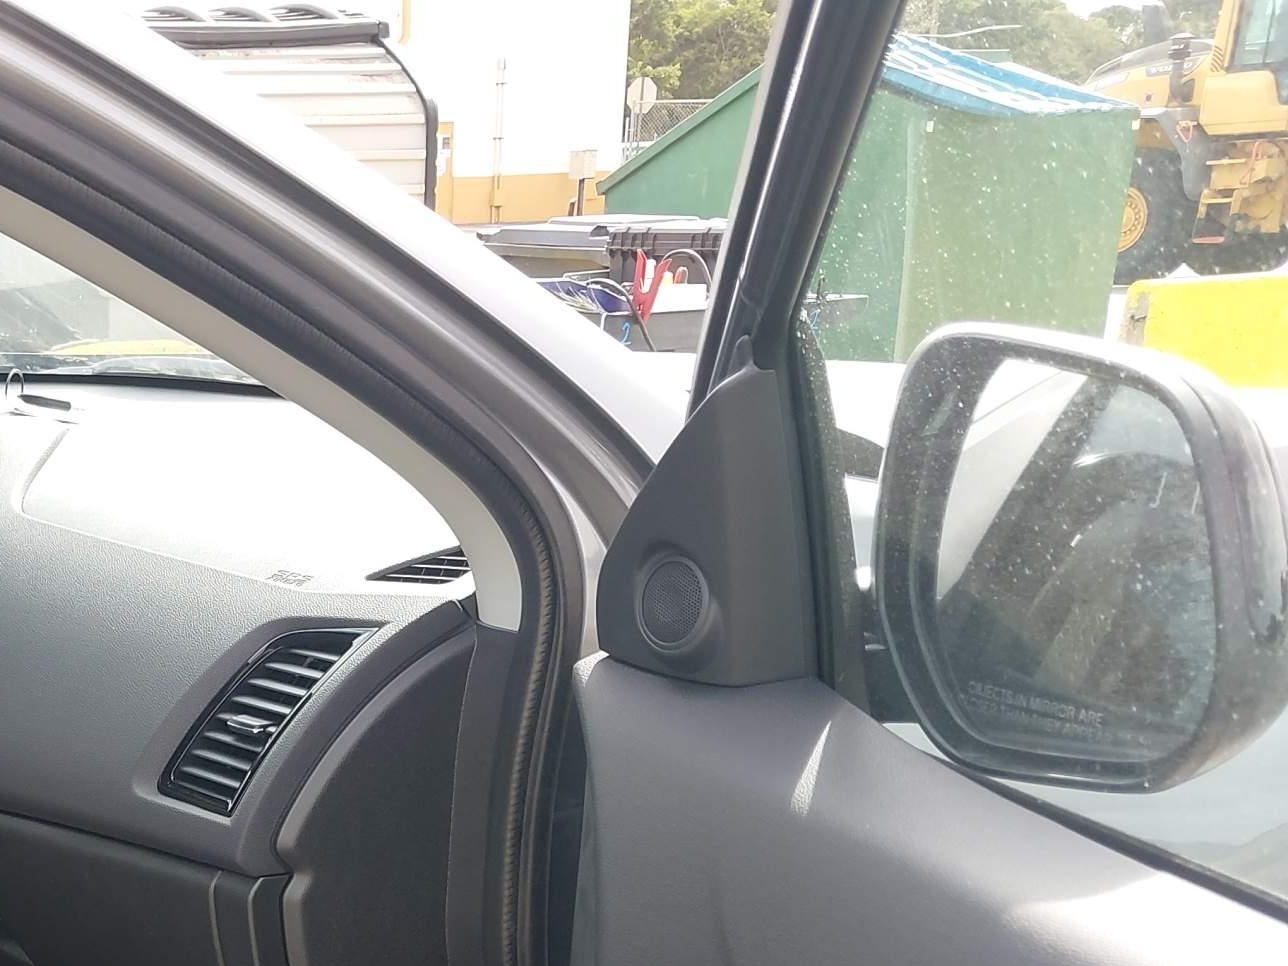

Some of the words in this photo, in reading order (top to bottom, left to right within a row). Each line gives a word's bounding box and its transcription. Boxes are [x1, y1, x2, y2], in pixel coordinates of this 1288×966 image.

[620, 322, 631, 345] 2
[1029, 696, 1076, 719] MIRROR
[1078, 708, 1105, 728] ARE
